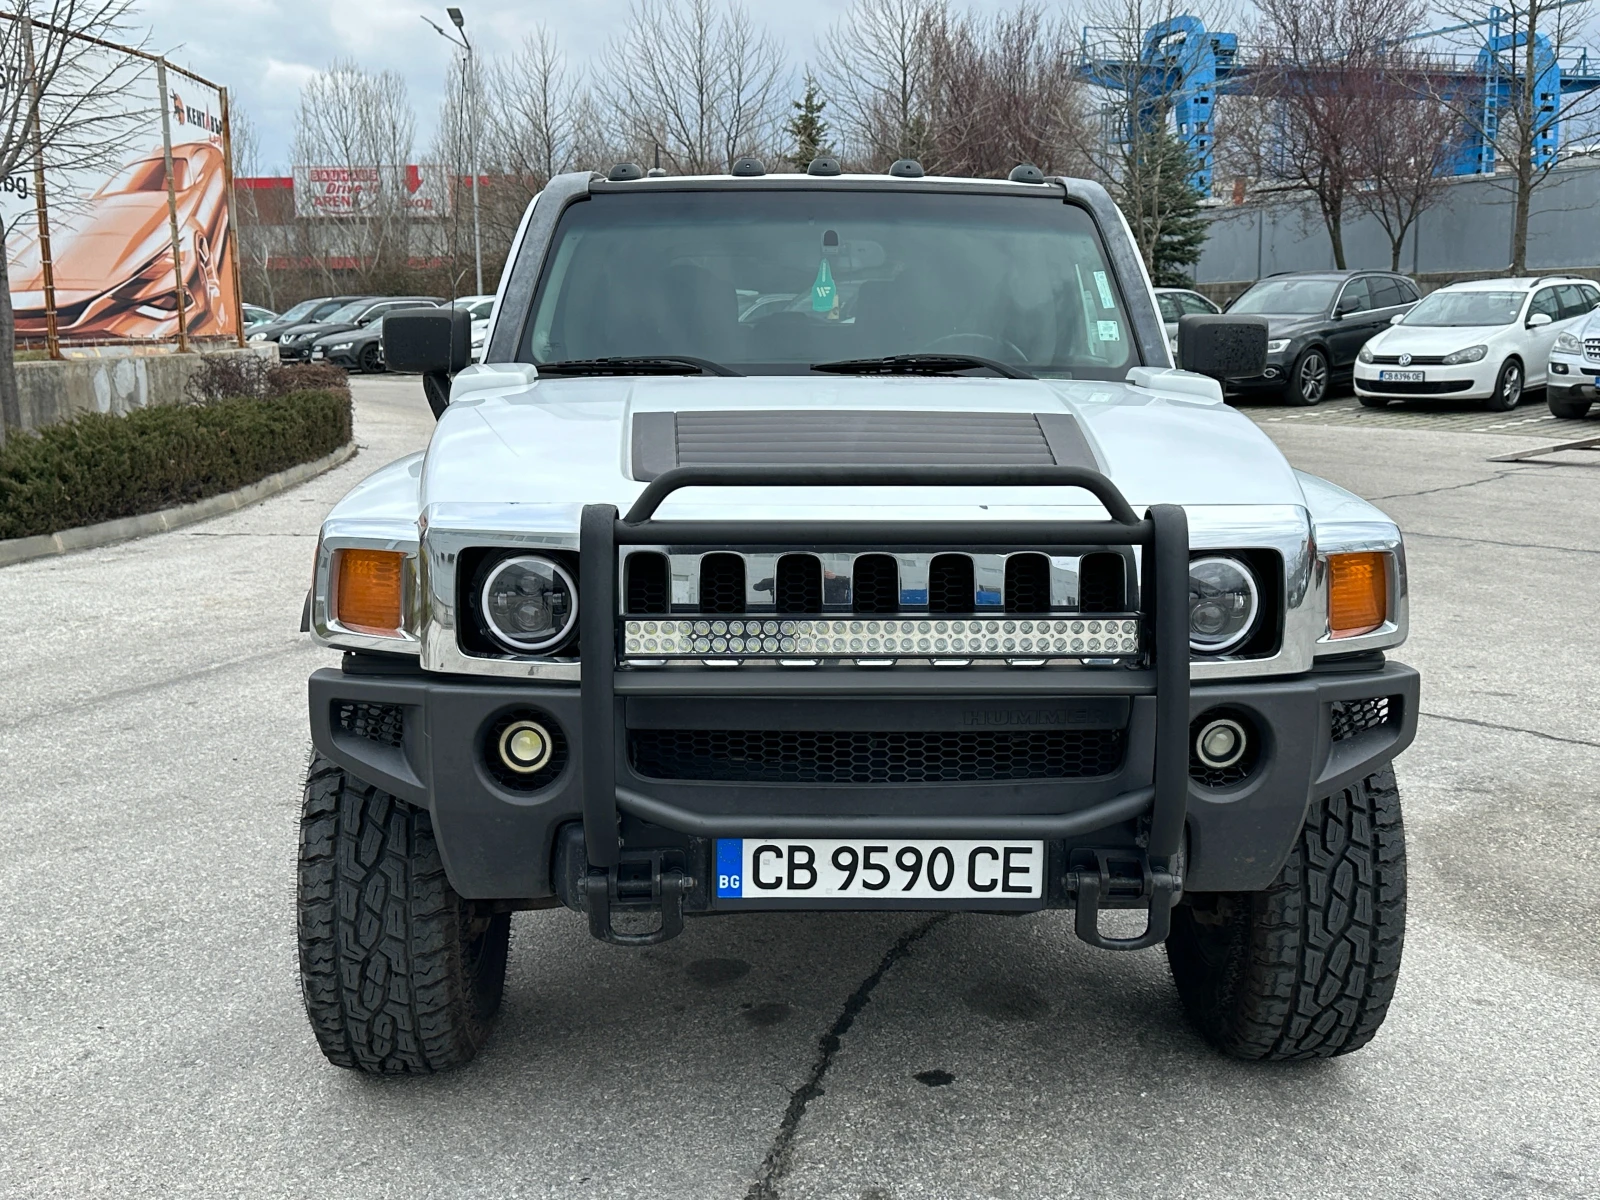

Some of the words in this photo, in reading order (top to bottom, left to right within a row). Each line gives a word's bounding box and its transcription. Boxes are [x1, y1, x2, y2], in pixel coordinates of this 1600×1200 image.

[311, 169, 378, 182] BAUHAUS
[963, 709, 1111, 726] HUMMER
[719, 875, 740, 889] BG
[752, 844, 818, 890] CB
[831, 846, 955, 892] 9590
[967, 846, 1034, 893] CE
